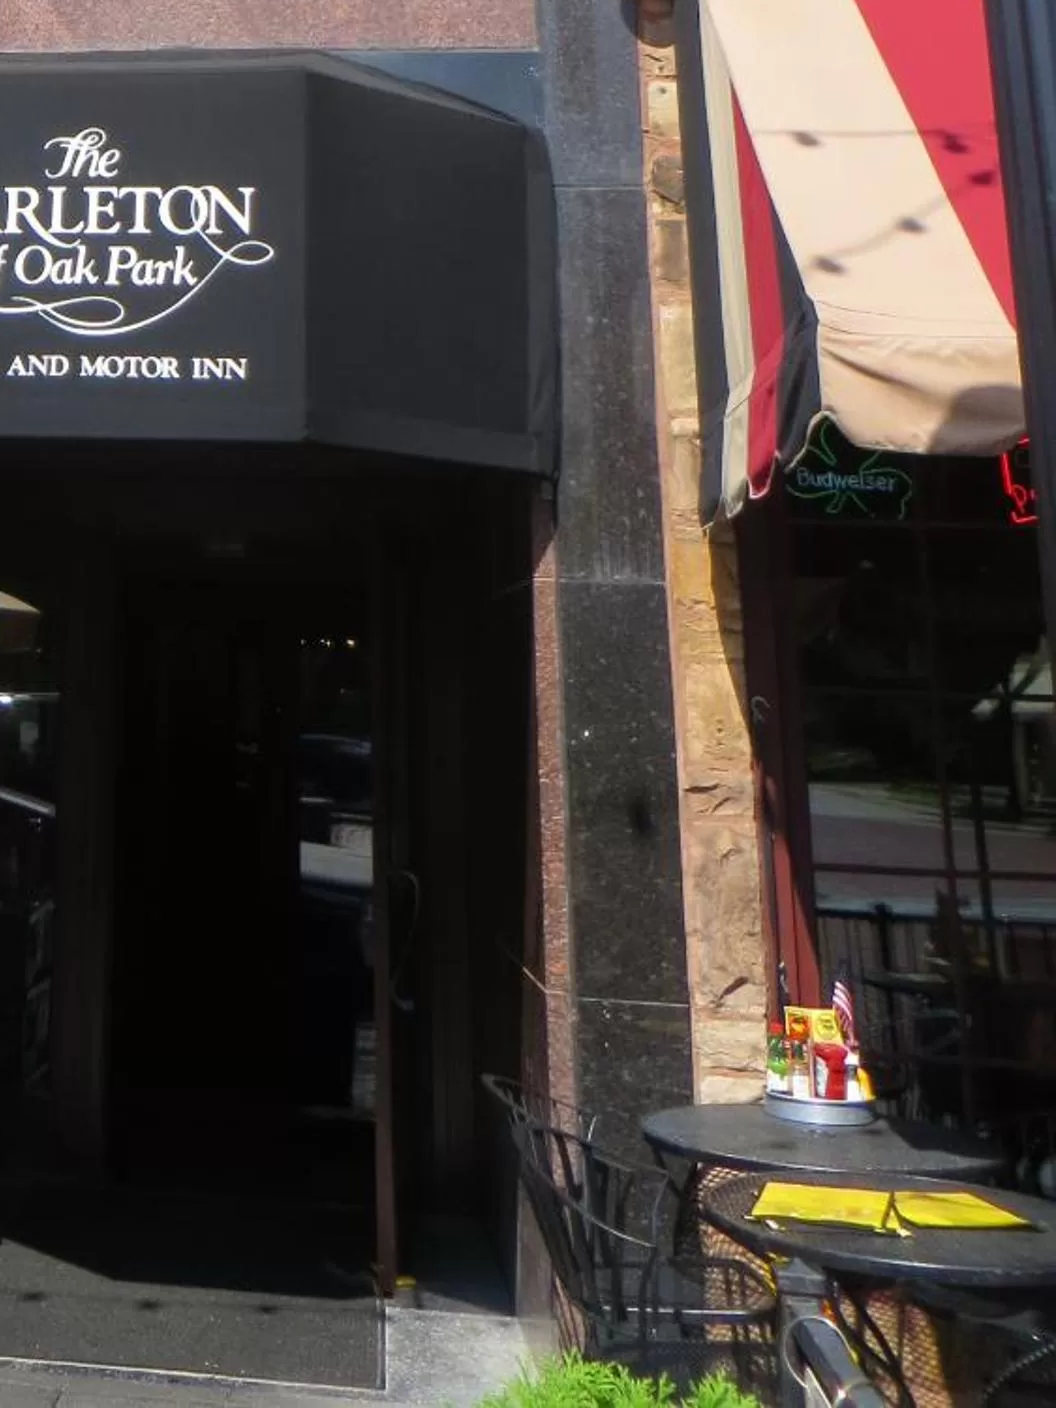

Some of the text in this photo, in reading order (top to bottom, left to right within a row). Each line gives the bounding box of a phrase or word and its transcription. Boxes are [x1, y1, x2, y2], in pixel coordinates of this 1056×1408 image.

[43, 127, 121, 179] The
[15, 243, 99, 286] Oak
[105, 244, 198, 287] Park
[7, 354, 69, 378] AND
[80, 355, 180, 379] MOTOR
[192, 357, 248, 381] INN
[796, 466, 897, 492] Budweiser
